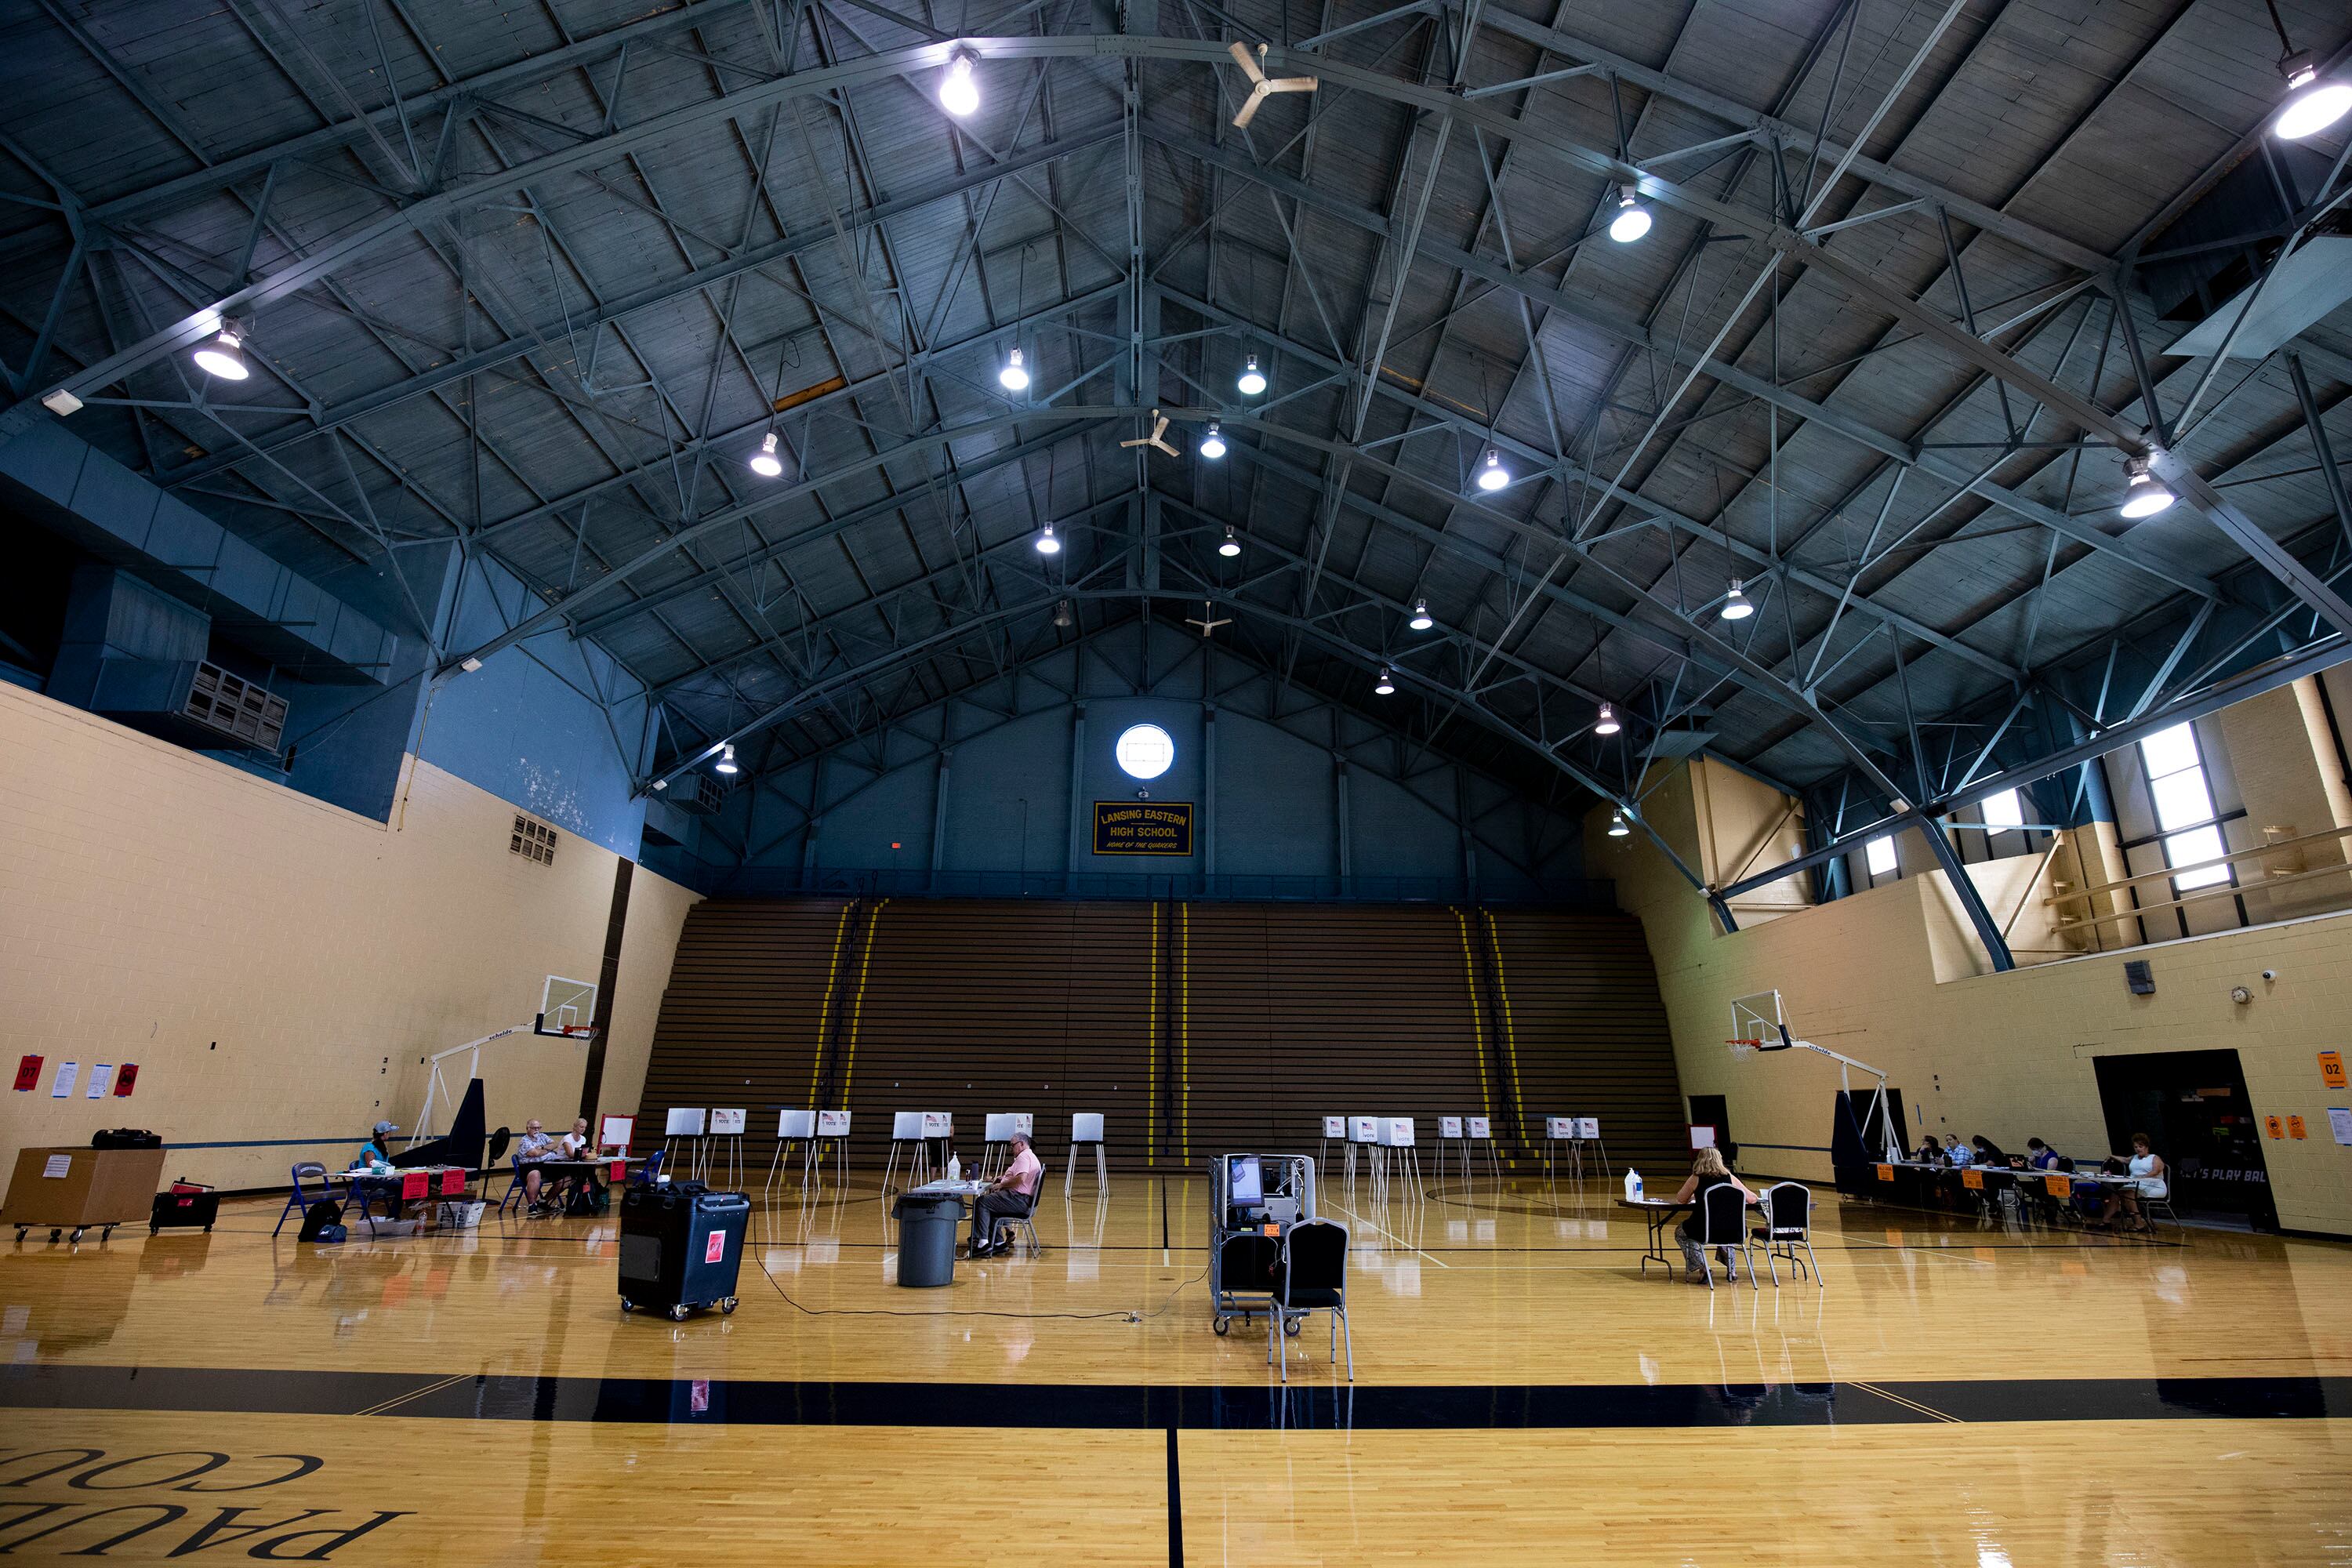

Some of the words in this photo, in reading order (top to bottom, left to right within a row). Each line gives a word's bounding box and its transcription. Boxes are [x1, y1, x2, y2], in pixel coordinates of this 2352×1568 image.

[1101, 809, 1142, 825] LANSING
[1144, 809, 1187, 826] EASTERN
[1110, 827, 1134, 837] HIGH
[1138, 827, 1178, 837] SCHOOL
[22, 1067, 37, 1078] 07
[2325, 1064, 2340, 1074] 02
[2211, 1169, 2241, 1181] PLAY
[0, 1448, 324, 1492] COU
